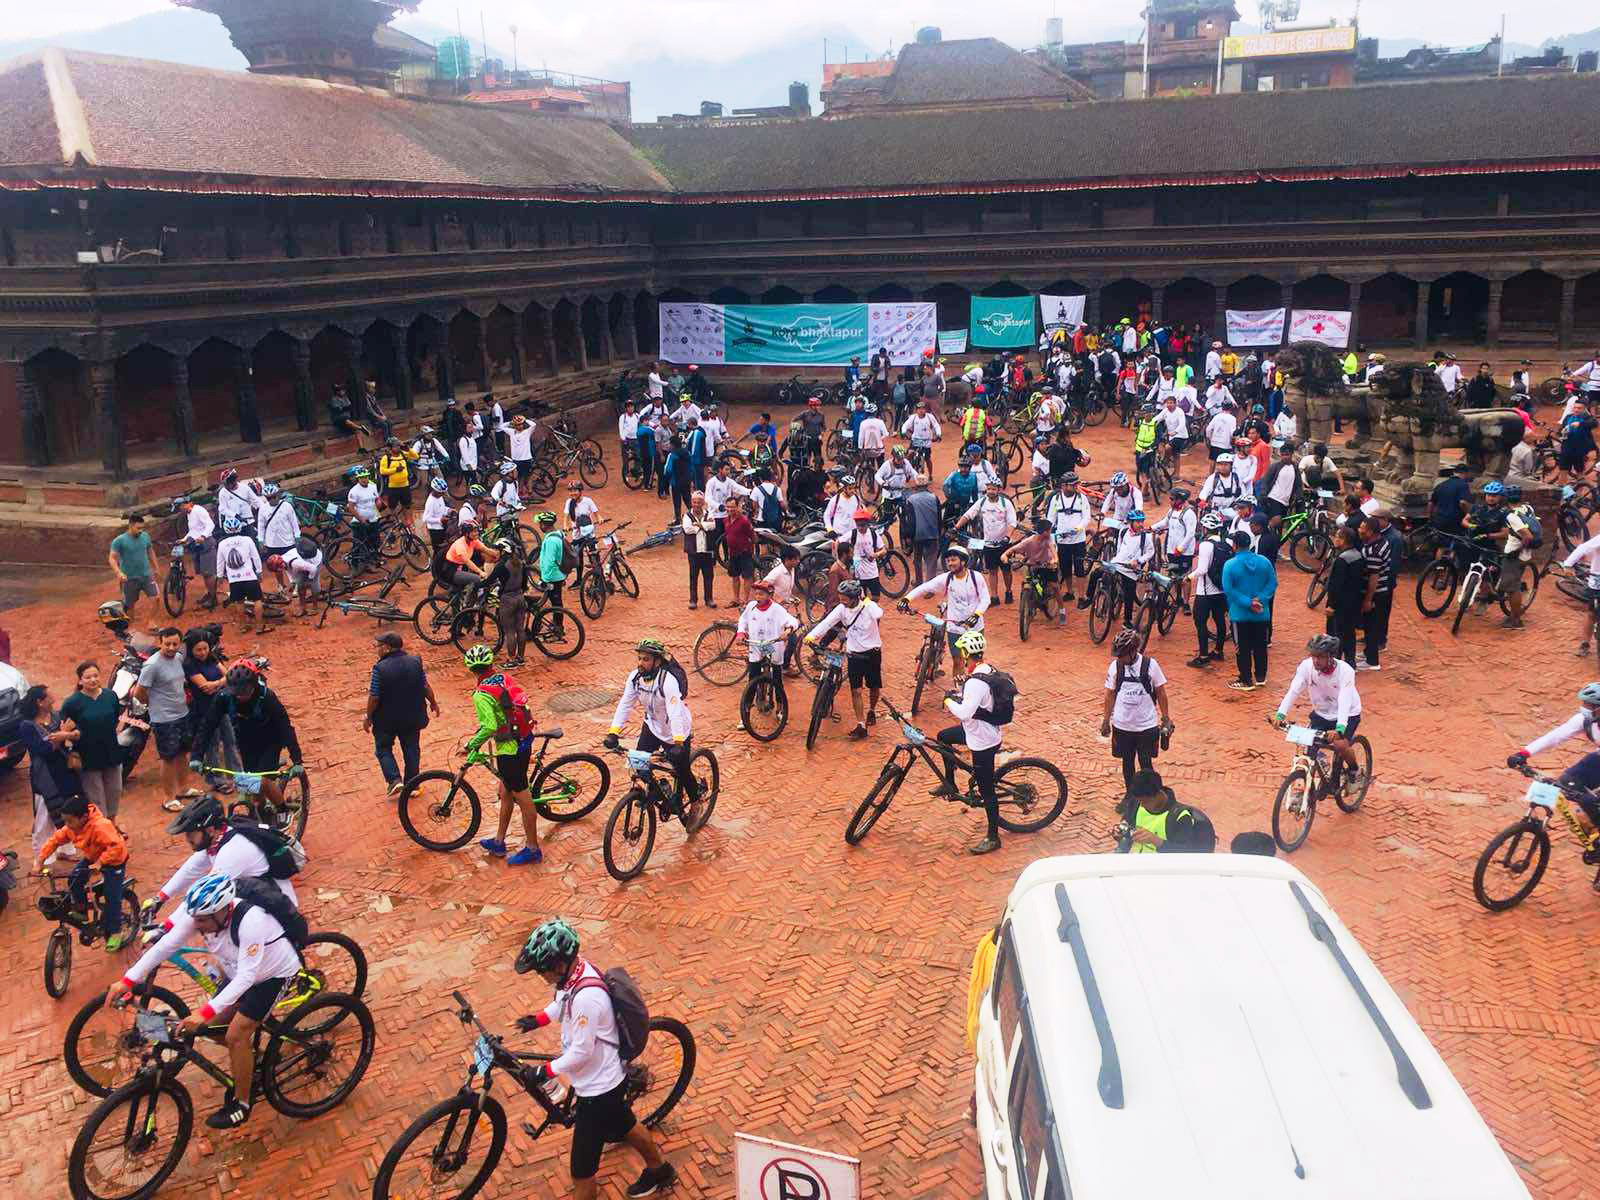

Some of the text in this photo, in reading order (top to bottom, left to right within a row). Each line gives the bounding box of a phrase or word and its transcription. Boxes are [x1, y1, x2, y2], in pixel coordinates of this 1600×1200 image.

[1244, 30, 1350, 55] GOLDEN GATE GUEST HOUSE
